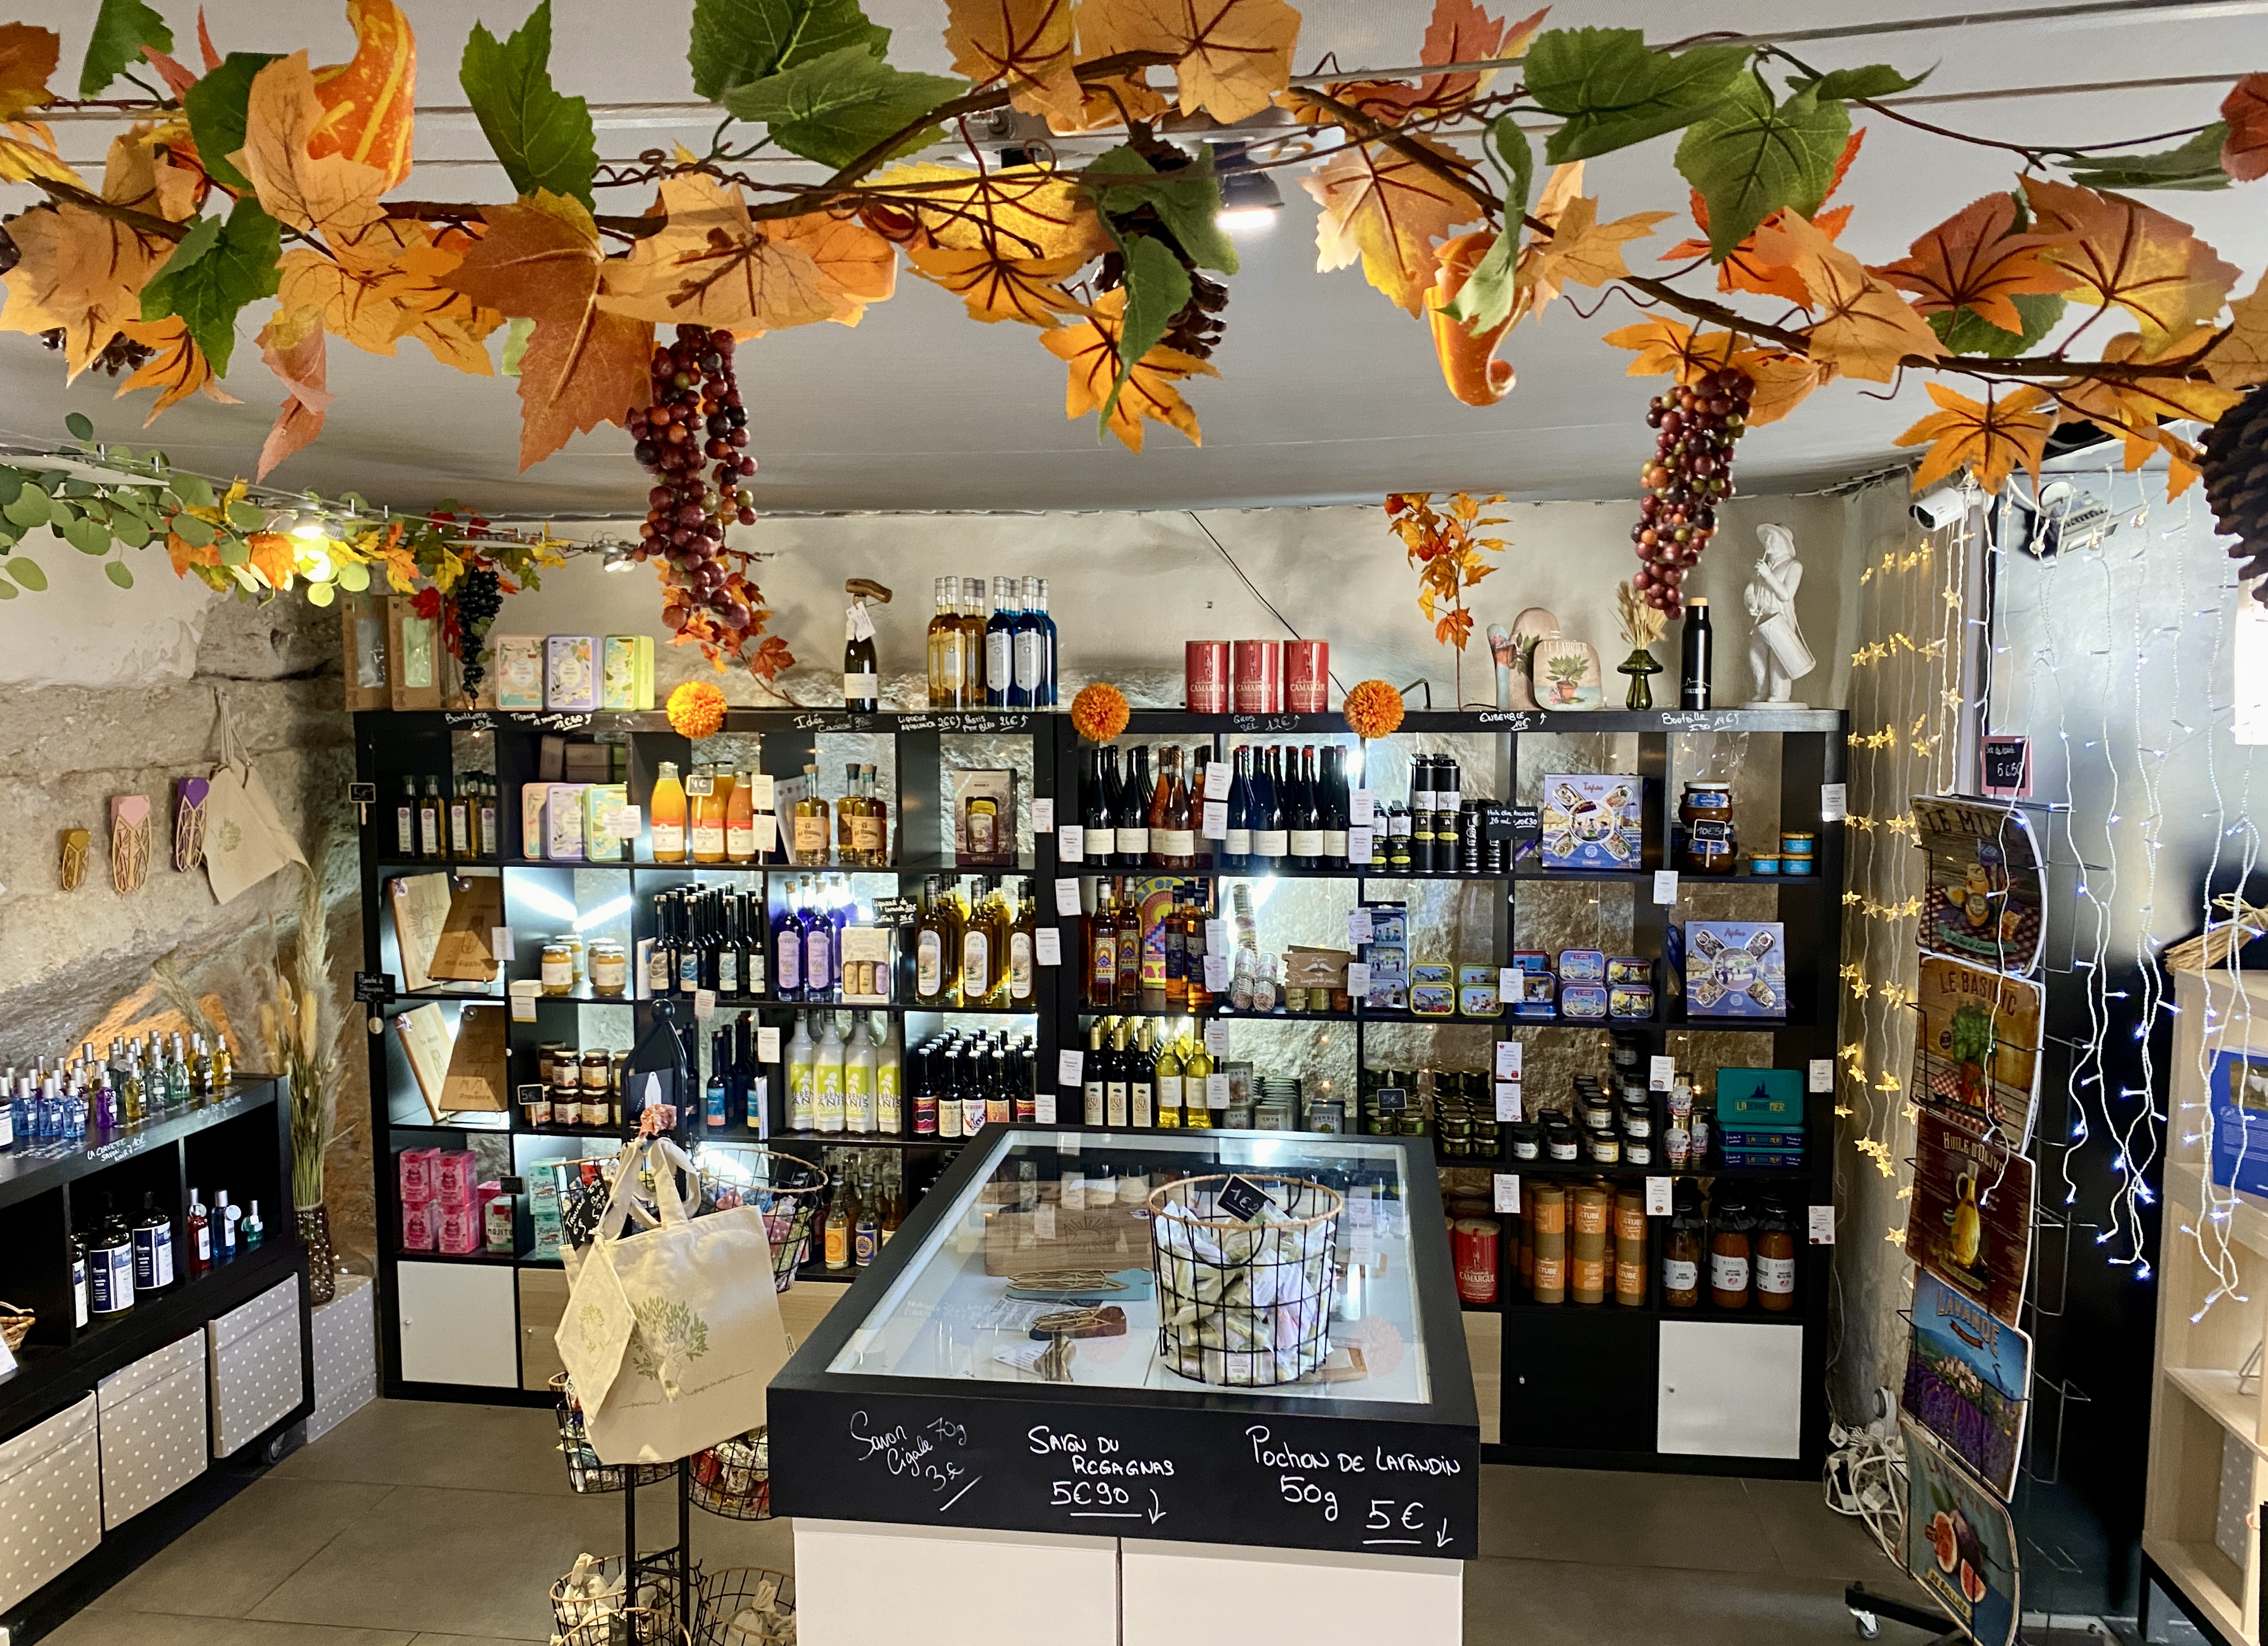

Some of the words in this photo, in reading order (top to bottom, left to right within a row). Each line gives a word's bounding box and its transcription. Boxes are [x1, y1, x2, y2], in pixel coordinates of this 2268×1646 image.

[1926, 808, 1952, 834] LE
[1940, 971, 1957, 994] LE
[87, 1150, 95, 1160] LA
[1937, 1286, 2000, 1359] LAVANDE
[850, 1410, 908, 1461] Savon
[1098, 1437, 1120, 1452] DU
[1337, 1452, 1366, 1473] DE
[1050, 1481, 1130, 1505] 5€90
[1280, 1474, 1338, 1522] 50g
[1365, 1499, 1424, 1530] 5€
